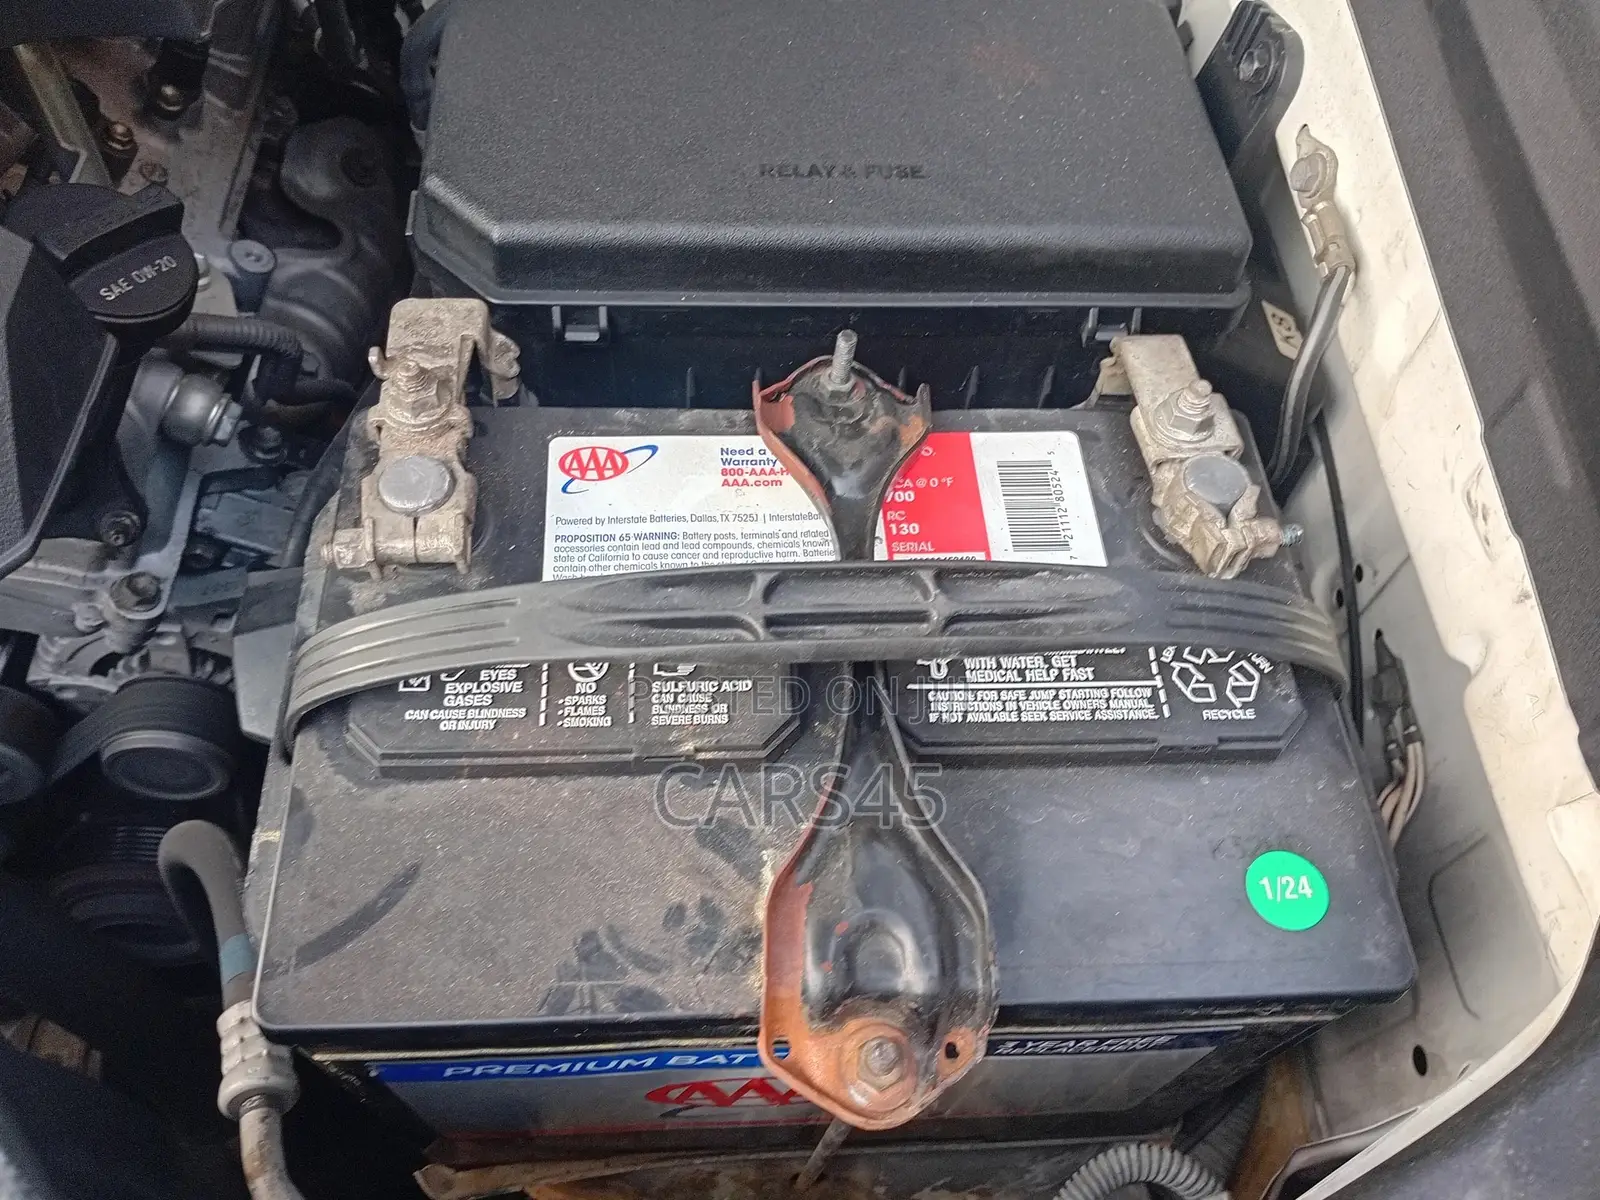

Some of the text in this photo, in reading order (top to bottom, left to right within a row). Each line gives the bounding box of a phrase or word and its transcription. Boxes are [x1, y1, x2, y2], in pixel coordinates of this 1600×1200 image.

[759, 163, 836, 179] RELAY
[864, 164, 926, 179] FUSE
[99, 255, 177, 301] SAE 0W-20
[720, 447, 767, 456] Need a
[559, 446, 629, 481] AAA
[720, 457, 778, 467] Warranty
[721, 478, 783, 487] AAA.com
[916, 478, 927, 488] @
[929, 478, 939, 488] 0
[1049, 470, 1065, 502] 80524
[555, 516, 593, 526] Powered
[595, 516, 605, 526] by
[607, 515, 648, 524] Interstate
[649, 513, 689, 523] Batteries,
[690, 513, 719, 523] Dallas,
[720, 513, 730, 522] TX
[887, 510, 906, 521] RC
[889, 523, 920, 535] 130
[1057, 507, 1074, 540] 21112
[554, 529, 829, 543] PROPOSITION 65 WARNING: Battery posts, terminals and related
[553, 539, 830, 553] accessories contain lead and lead compounds, chemicals known
[891, 541, 936, 552] SERIAL
[553, 554, 575, 563] state
[577, 553, 587, 562] of
[588, 553, 630, 562] California
[631, 552, 641, 561] to
[670, 551, 700, 560] cancer
[702, 550, 719, 559] and
[721, 549, 774, 560] reproductive
[775, 549, 801, 558] harm.
[552, 564, 587, 574] contain
[588, 562, 611, 572] other
[613, 561, 658, 571] chemicals
[660, 561, 688, 569] known
[963, 656, 998, 669] WITH
[1051, 655, 1078, 668] GET
[479, 668, 518, 681] EYES
[965, 667, 1095, 683] MEDICAL HELP FAST
[444, 680, 524, 694] EXPLOSIVE
[574, 682, 597, 694] NO
[651, 680, 753, 693] SULFURIC ACID
[442, 694, 494, 706] GASES
[650, 692, 713, 704] CAN CAUSE
[976, 690, 999, 701] FOR
[1000, 689, 1028, 701] SAFE
[1028, 689, 1057, 701] JUMP
[1058, 688, 1110, 700] STARTING
[1109, 687, 1153, 699] FOLLOW
[650, 703, 729, 715] BLINDNESS OR
[930, 698, 1155, 712] INSTRUCTIONS IN VEHICLE OWNERS MANUAL.
[404, 707, 527, 720] CAN CAUSE BLINDNESS
[650, 714, 730, 726] SEVERE BURNS
[928, 709, 1160, 723] IF NOT AVAILABLE SEEK SERVICE ASSISTANCE.
[1202, 708, 1256, 721] RECYCLE
[439, 719, 498, 731] OR INJURY
[1257, 875, 1313, 904] 1/24
[443, 1056, 658, 1077] PREMIUM
